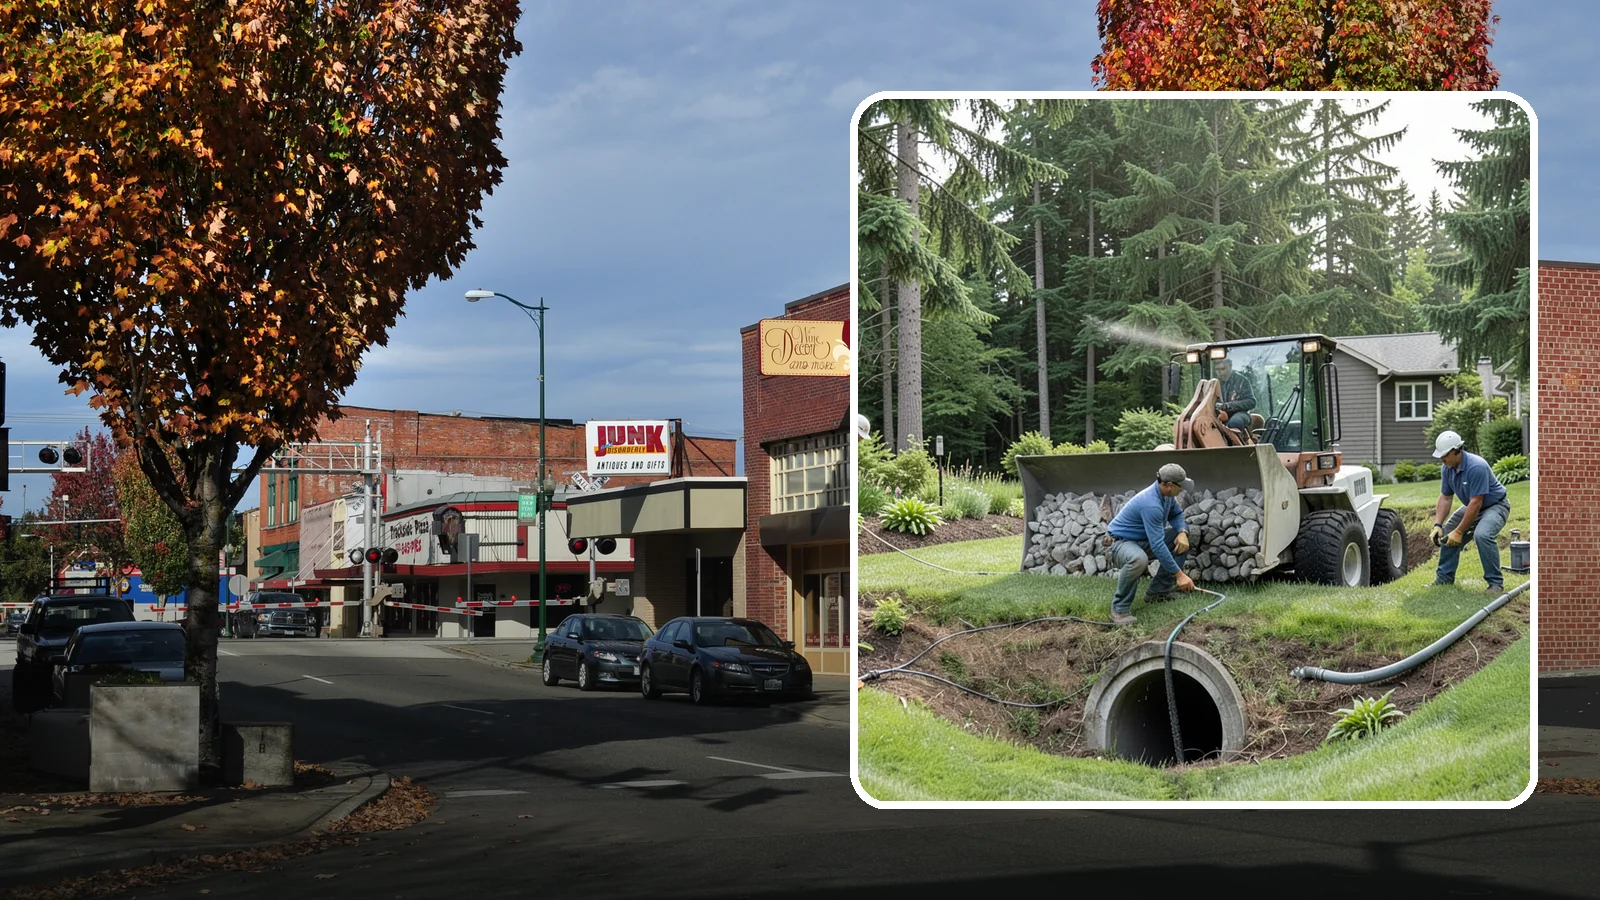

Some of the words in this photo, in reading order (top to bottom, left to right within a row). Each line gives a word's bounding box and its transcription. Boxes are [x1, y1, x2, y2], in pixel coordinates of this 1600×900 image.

[595, 425, 664, 457] JUNK
[607, 446, 646, 454] DISORDERLY
[597, 461, 628, 470] ANTIQUES
[631, 461, 644, 470] AND
[647, 461, 665, 470] GIFTS
[390, 521, 413, 539] Trackside
[414, 519, 429, 534] Pizza
